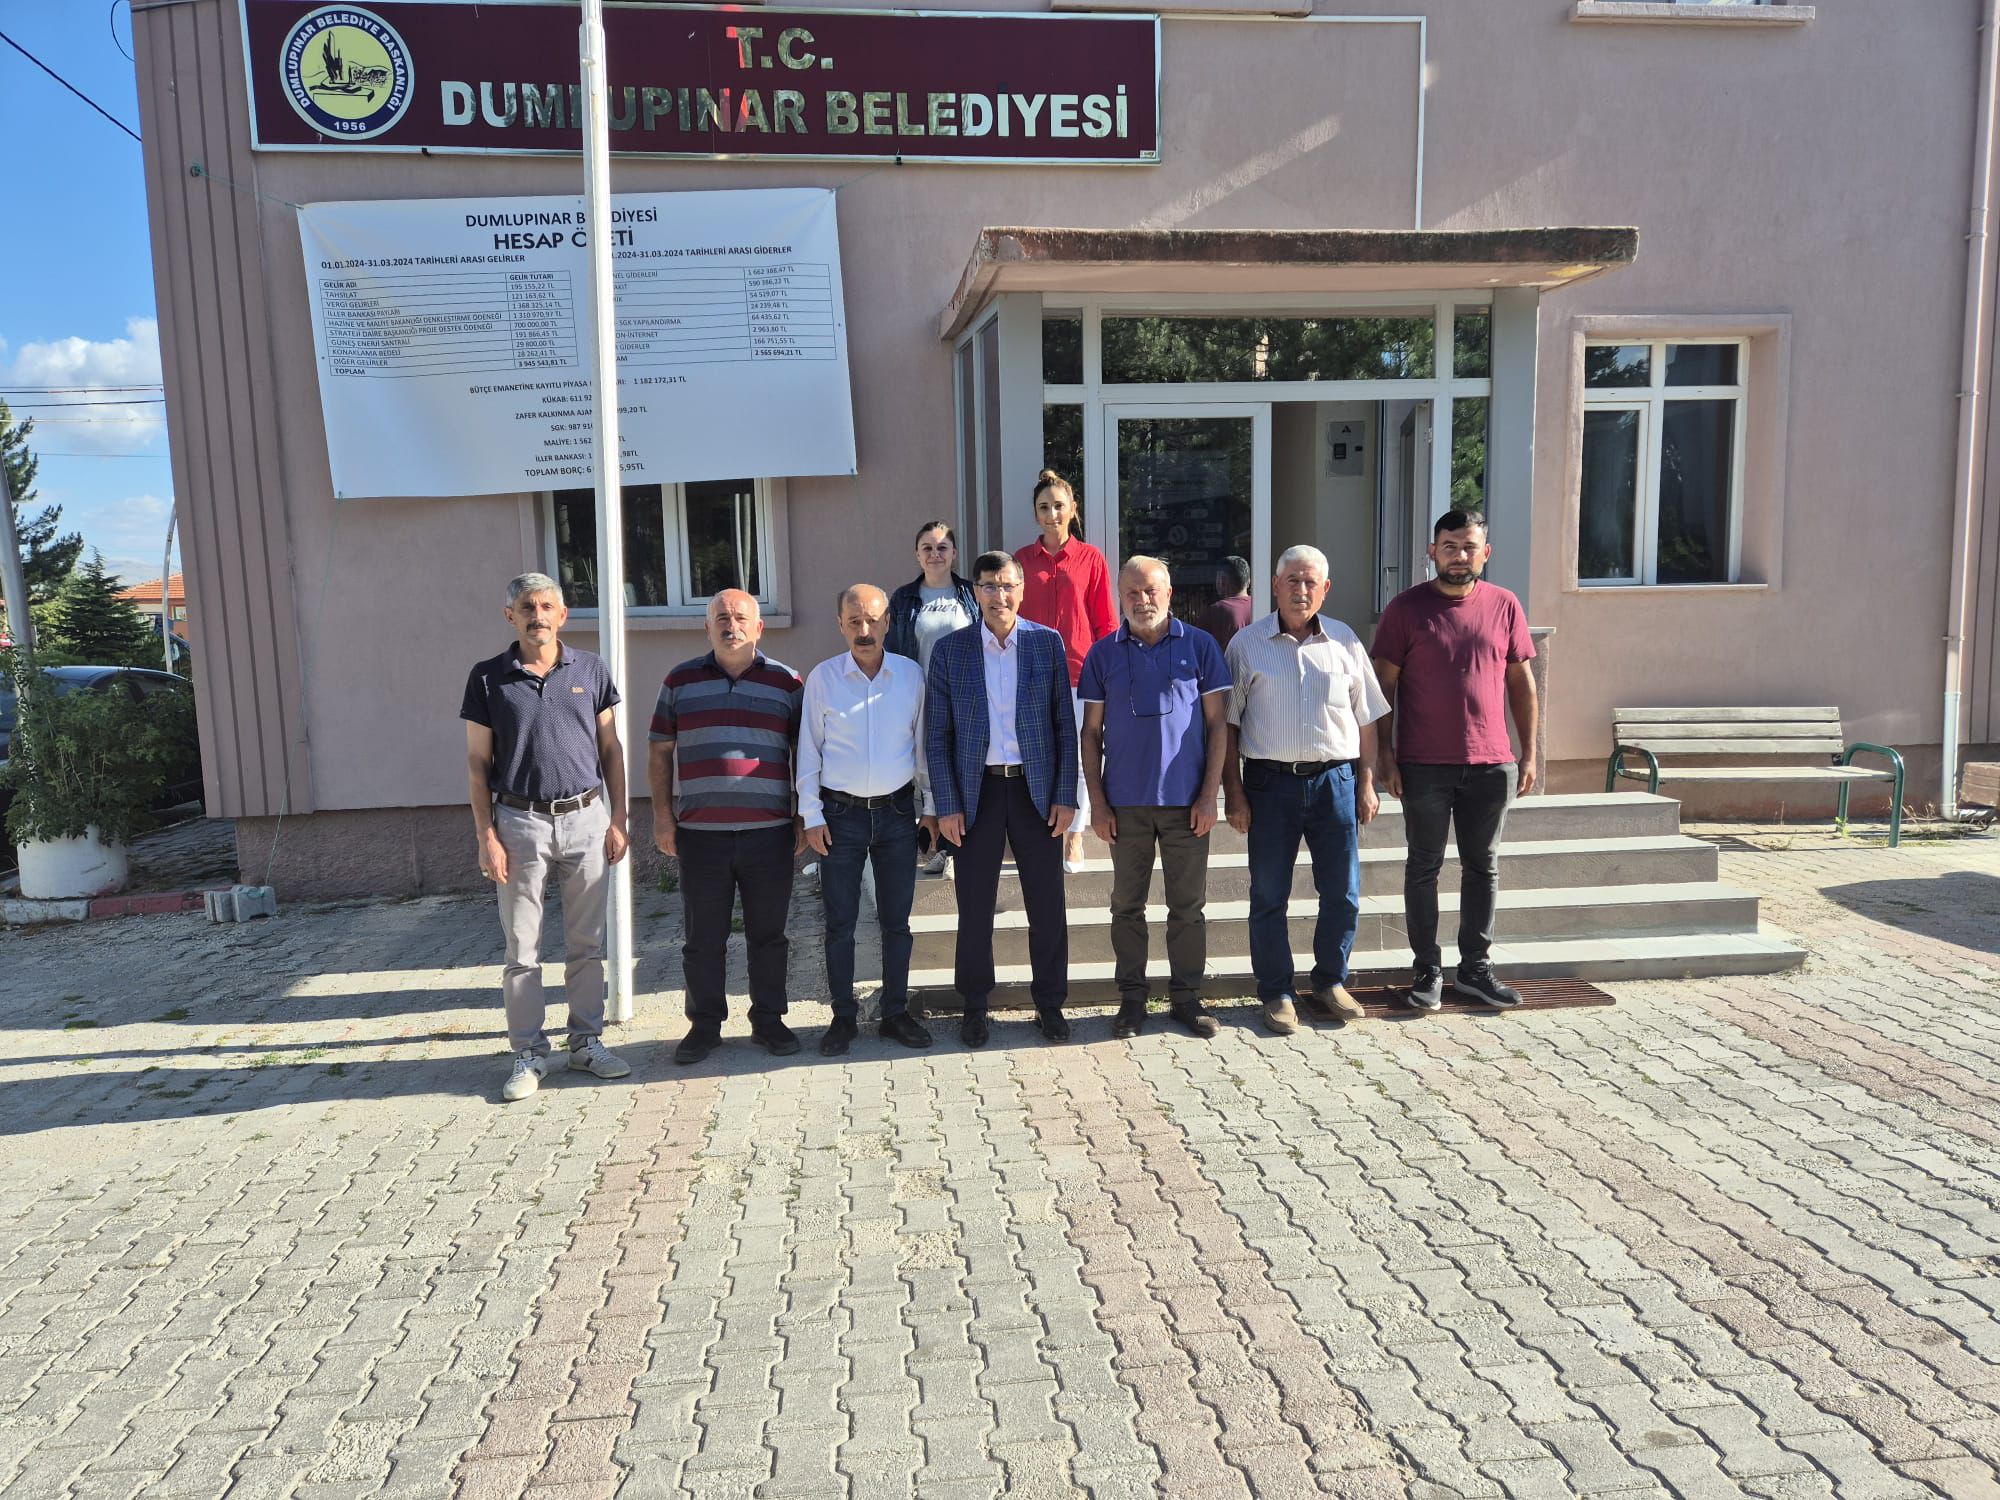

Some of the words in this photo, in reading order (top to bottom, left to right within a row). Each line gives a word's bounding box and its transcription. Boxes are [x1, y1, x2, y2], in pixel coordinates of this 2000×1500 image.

[726, 26, 834, 70] T.C.
[288, 24, 317, 108] DUMLUPINAR
[316, 13, 381, 35] BELEDİYE
[333, 121, 367, 131] 1956
[465, 212, 572, 227] DUMLUPINAR
[576, 206, 658, 224] BDİYESİ
[494, 232, 564, 250] HESAP
[571, 225, 634, 248] ÖTİ
[611, 249, 683, 259] .2024-31.03.2024
[685, 245, 726, 256] TARİHLERİ
[728, 246, 752, 255] ARASI
[753, 244, 792, 254] GİDERLER
[321, 257, 413, 270] 01.01.2024-31.03.2024
[415, 254, 458, 265] TARİHLERİ
[460, 255, 485, 264] ARASI
[487, 253, 526, 263] GELİRLER
[782, 301, 789, 309] TL
[615, 331, 658, 339] ON-İNTERNET
[332, 349, 377, 357] KONAKLAMA
[654, 376, 677, 385] 172,31
[678, 375, 687, 383] TL
[469, 385, 492, 395] BÜTÇE
[493, 382, 534, 392] EMANETİNE
[535, 381, 561, 390] KAYITLI
[563, 379, 588, 388] PİYASA
[515, 411, 537, 420] ZAFER
[538, 409, 575, 418] KALKINMA
[550, 424, 567, 432] SGK:
[568, 423, 581, 431] 987
[543, 436, 572, 446] MALİYE:
[554, 453, 585, 462] BANKASI:
[525, 467, 559, 477] TOPLAM
[560, 466, 585, 476] BORÇ:
